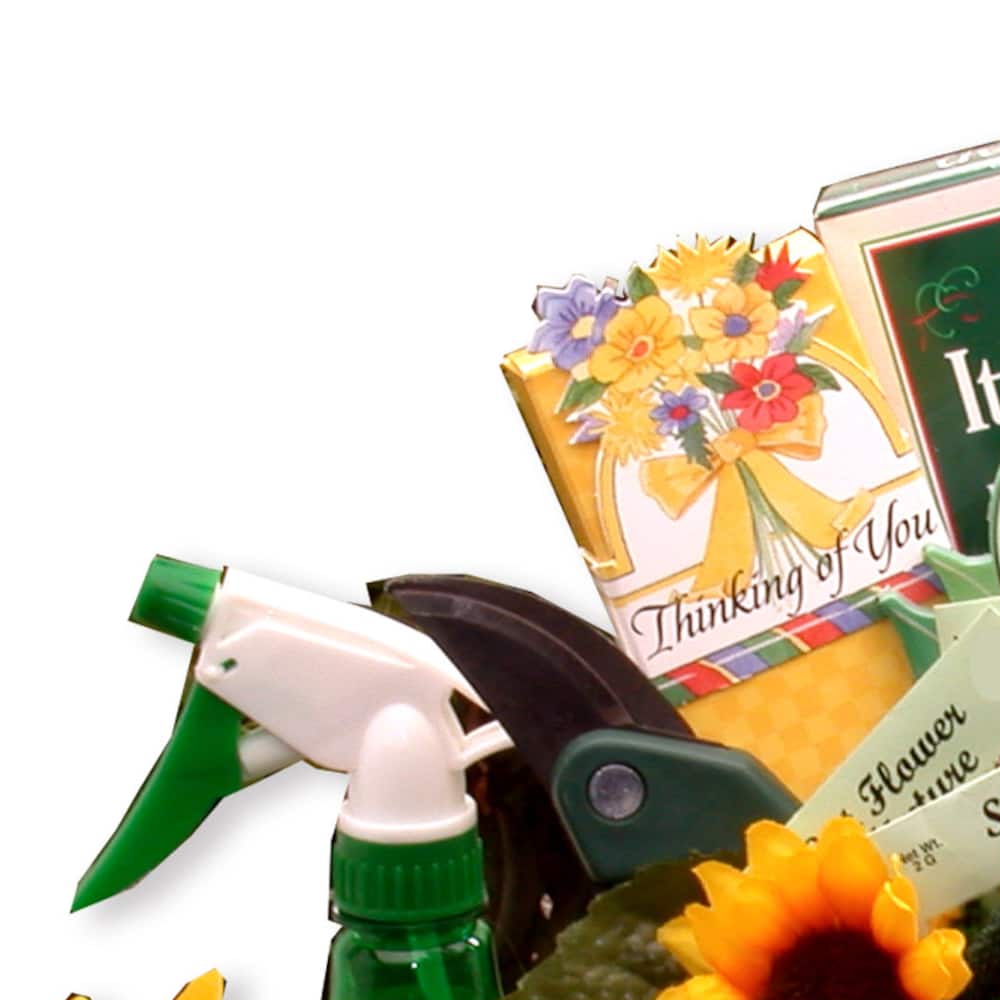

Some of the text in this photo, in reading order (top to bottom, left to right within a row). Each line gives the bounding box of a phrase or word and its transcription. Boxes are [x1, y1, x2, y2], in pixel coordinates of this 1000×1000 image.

[631, 498, 938, 660] Thinking of You
[858, 704, 967, 816] Flower
[909, 750, 979, 812] ture
